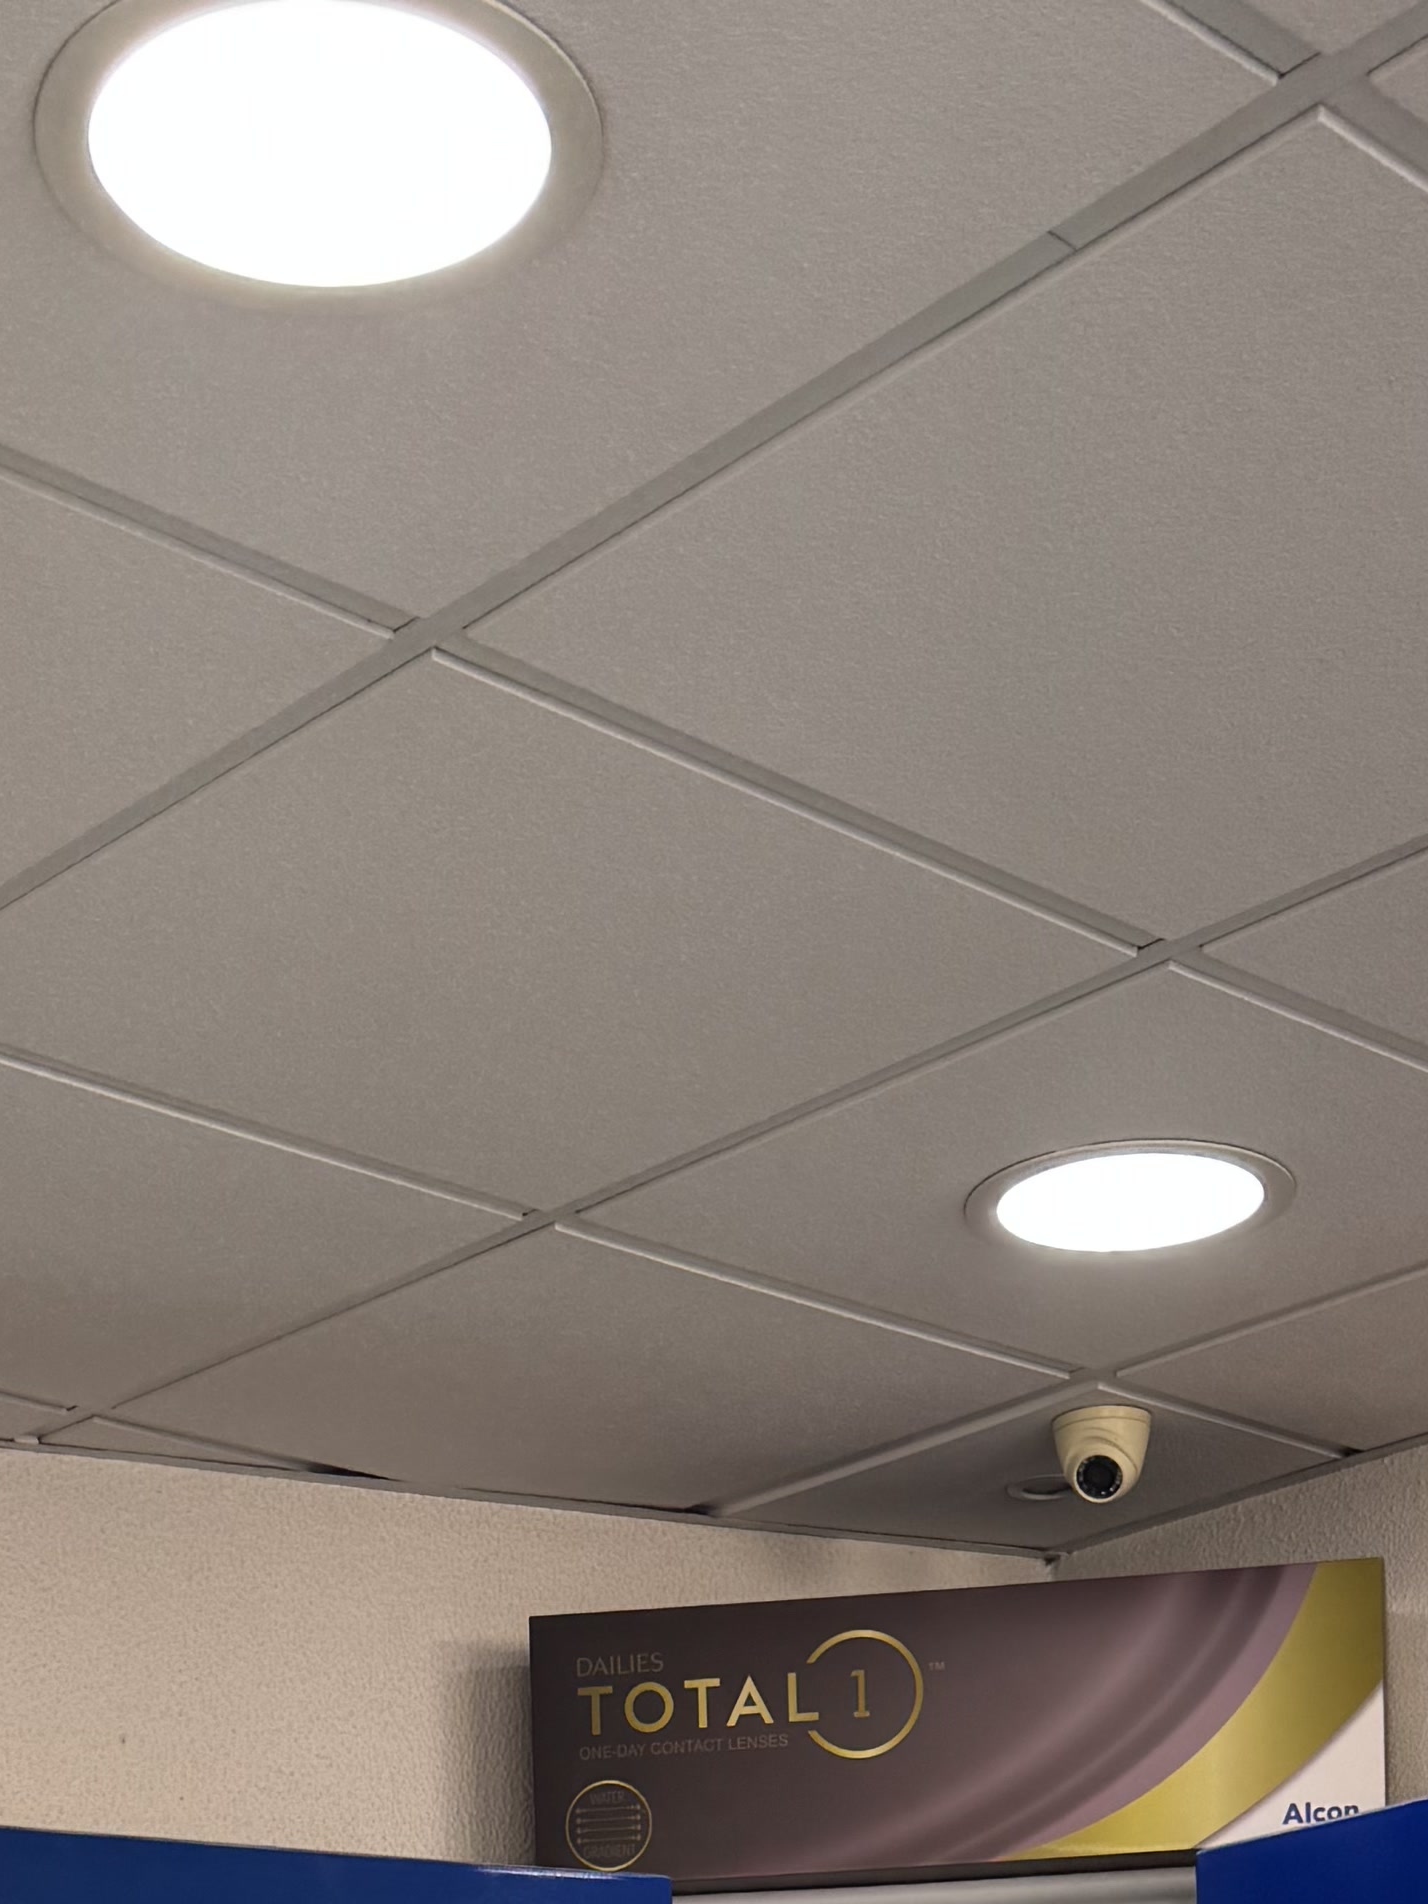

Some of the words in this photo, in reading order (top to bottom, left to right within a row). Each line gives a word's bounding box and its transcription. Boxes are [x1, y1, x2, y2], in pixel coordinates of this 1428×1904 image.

[576, 1653, 665, 1678] DAILIES
[577, 1672, 820, 1736] TOTAL
[580, 1743, 645, 1761] ONE-DAY
[651, 1737, 723, 1756] CONTACT
[728, 1733, 789, 1751] LENSES
